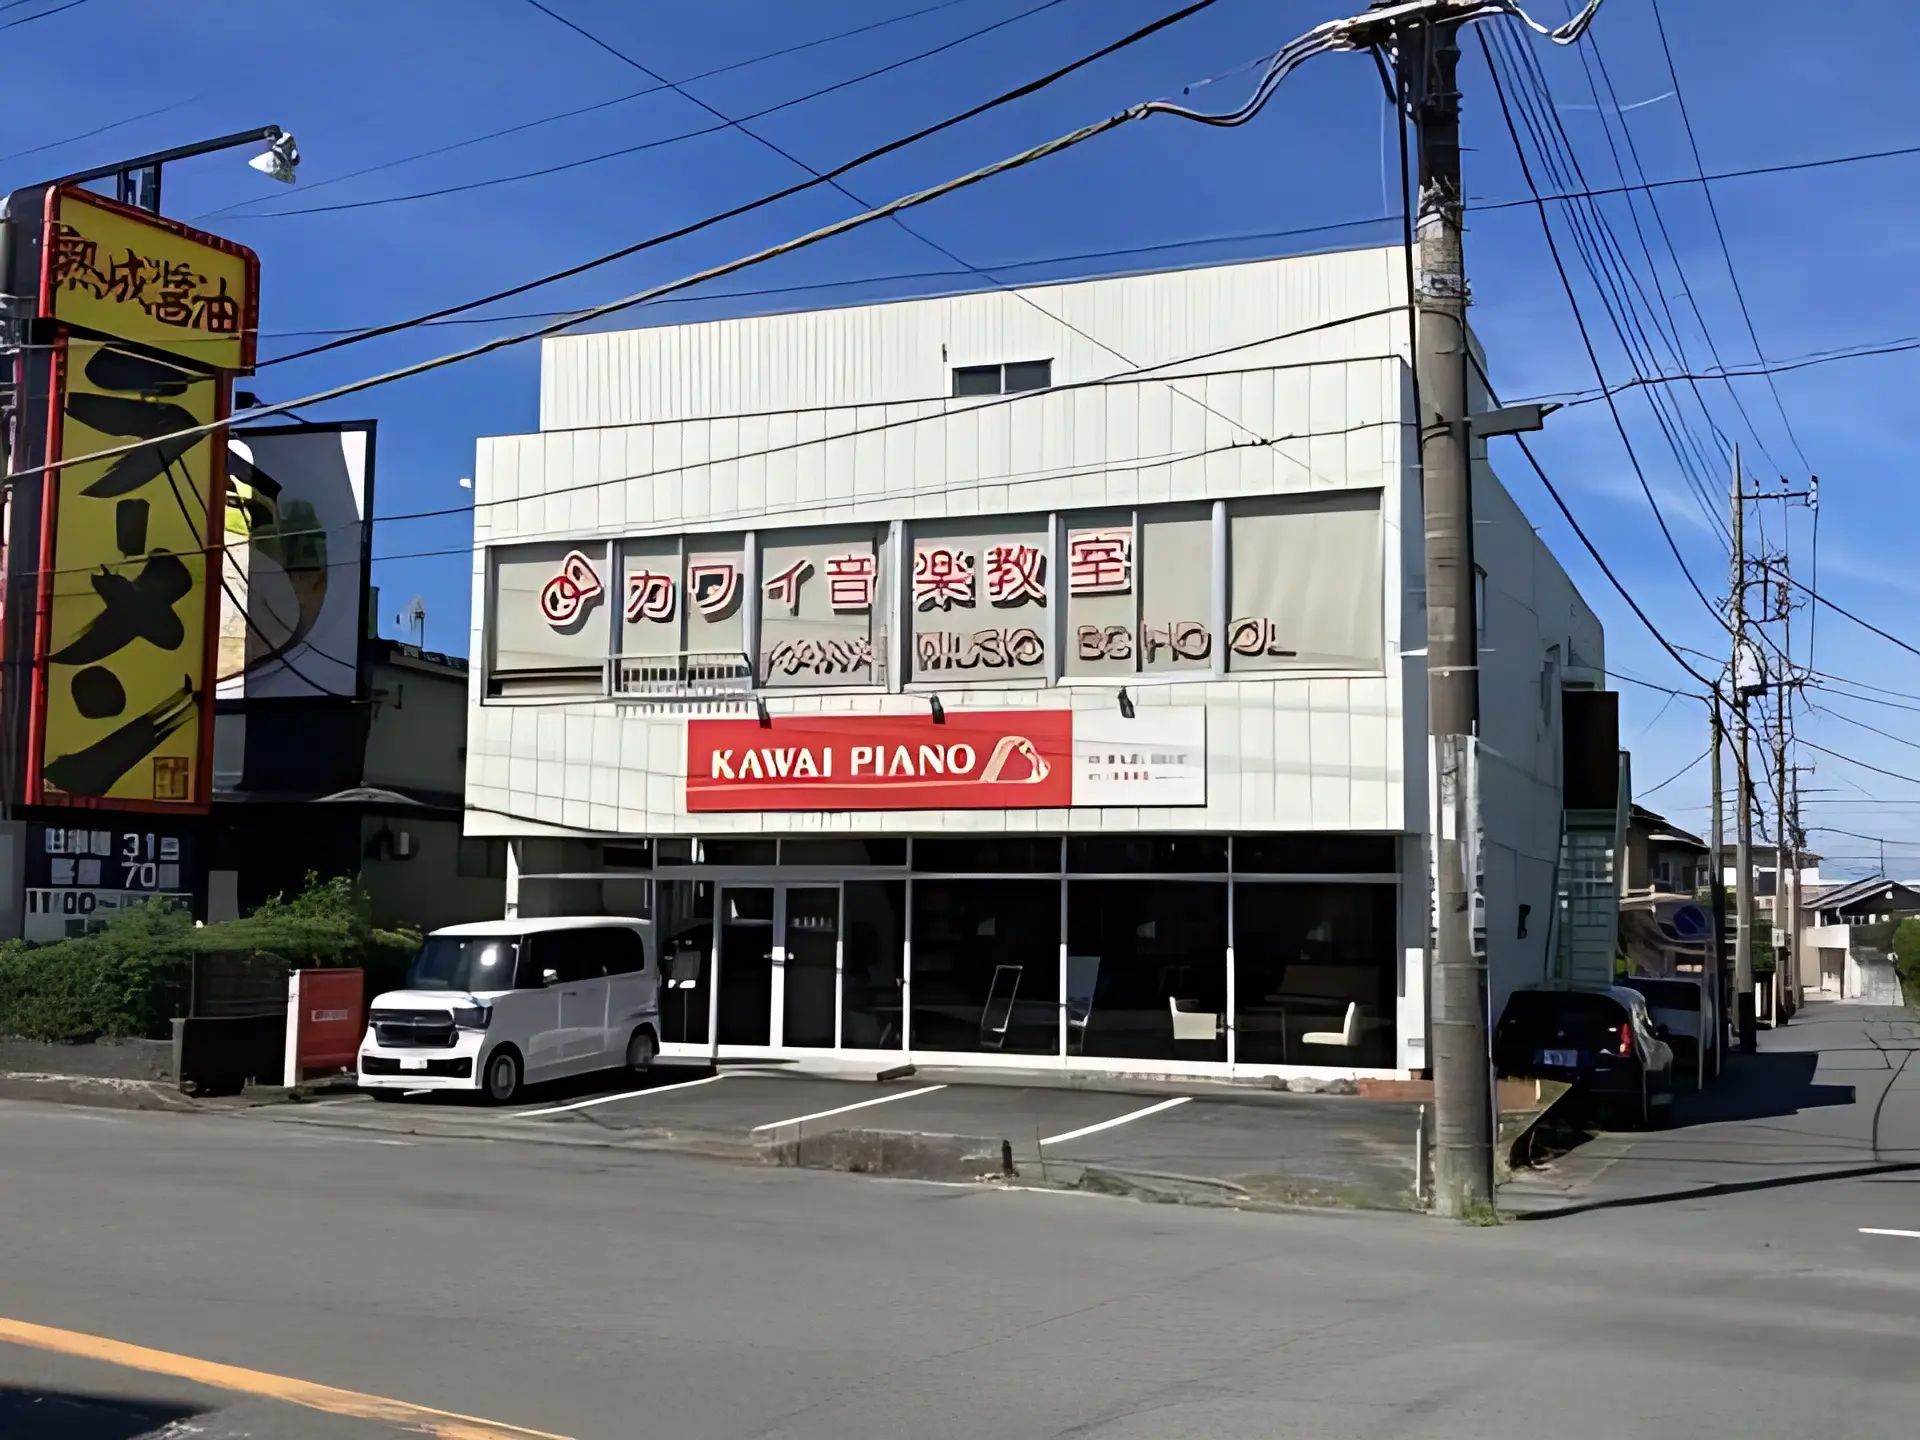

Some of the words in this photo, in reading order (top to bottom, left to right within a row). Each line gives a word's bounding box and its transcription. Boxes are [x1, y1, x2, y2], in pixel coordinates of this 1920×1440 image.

[57, 225, 240, 333] 熟成醤油
[42, 343, 216, 796] ラーメン
[626, 532, 1132, 624] カワイ音楽教室
[711, 747, 832, 780] KAWAI
[850, 743, 976, 778] PIANO
